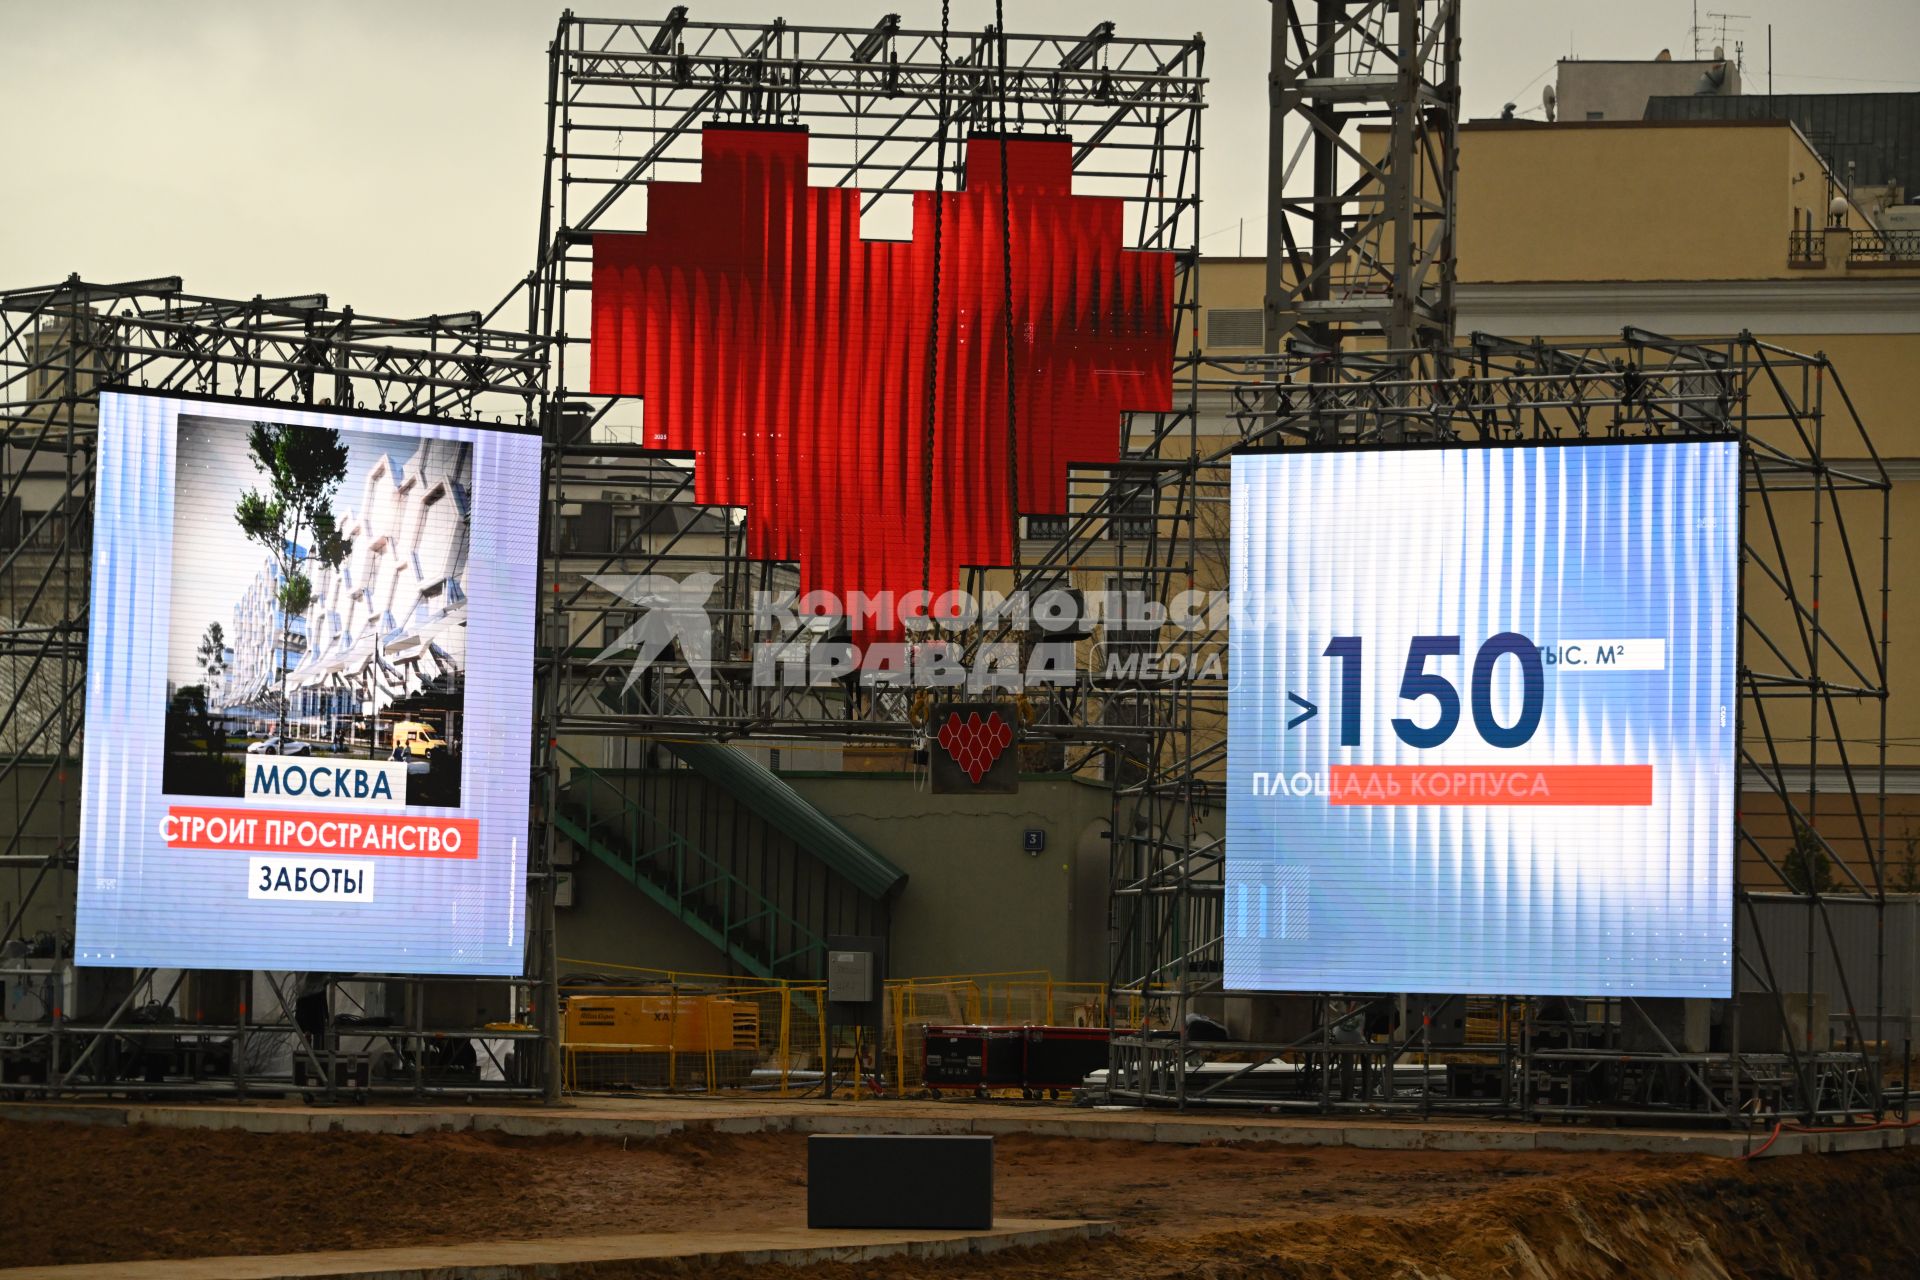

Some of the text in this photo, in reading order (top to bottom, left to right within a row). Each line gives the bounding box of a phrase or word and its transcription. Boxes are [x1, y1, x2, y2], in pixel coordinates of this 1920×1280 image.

[252, 764, 392, 800] МОСКВА
[1252, 772, 1550, 799] ПЛОЩАДЬ КОРПУСА
[158, 814, 462, 853] СТРОИТ ПРОСТРАНСТВО
[1029, 833, 1037, 844] 3
[258, 865, 364, 895] ЗАБОТЫ
